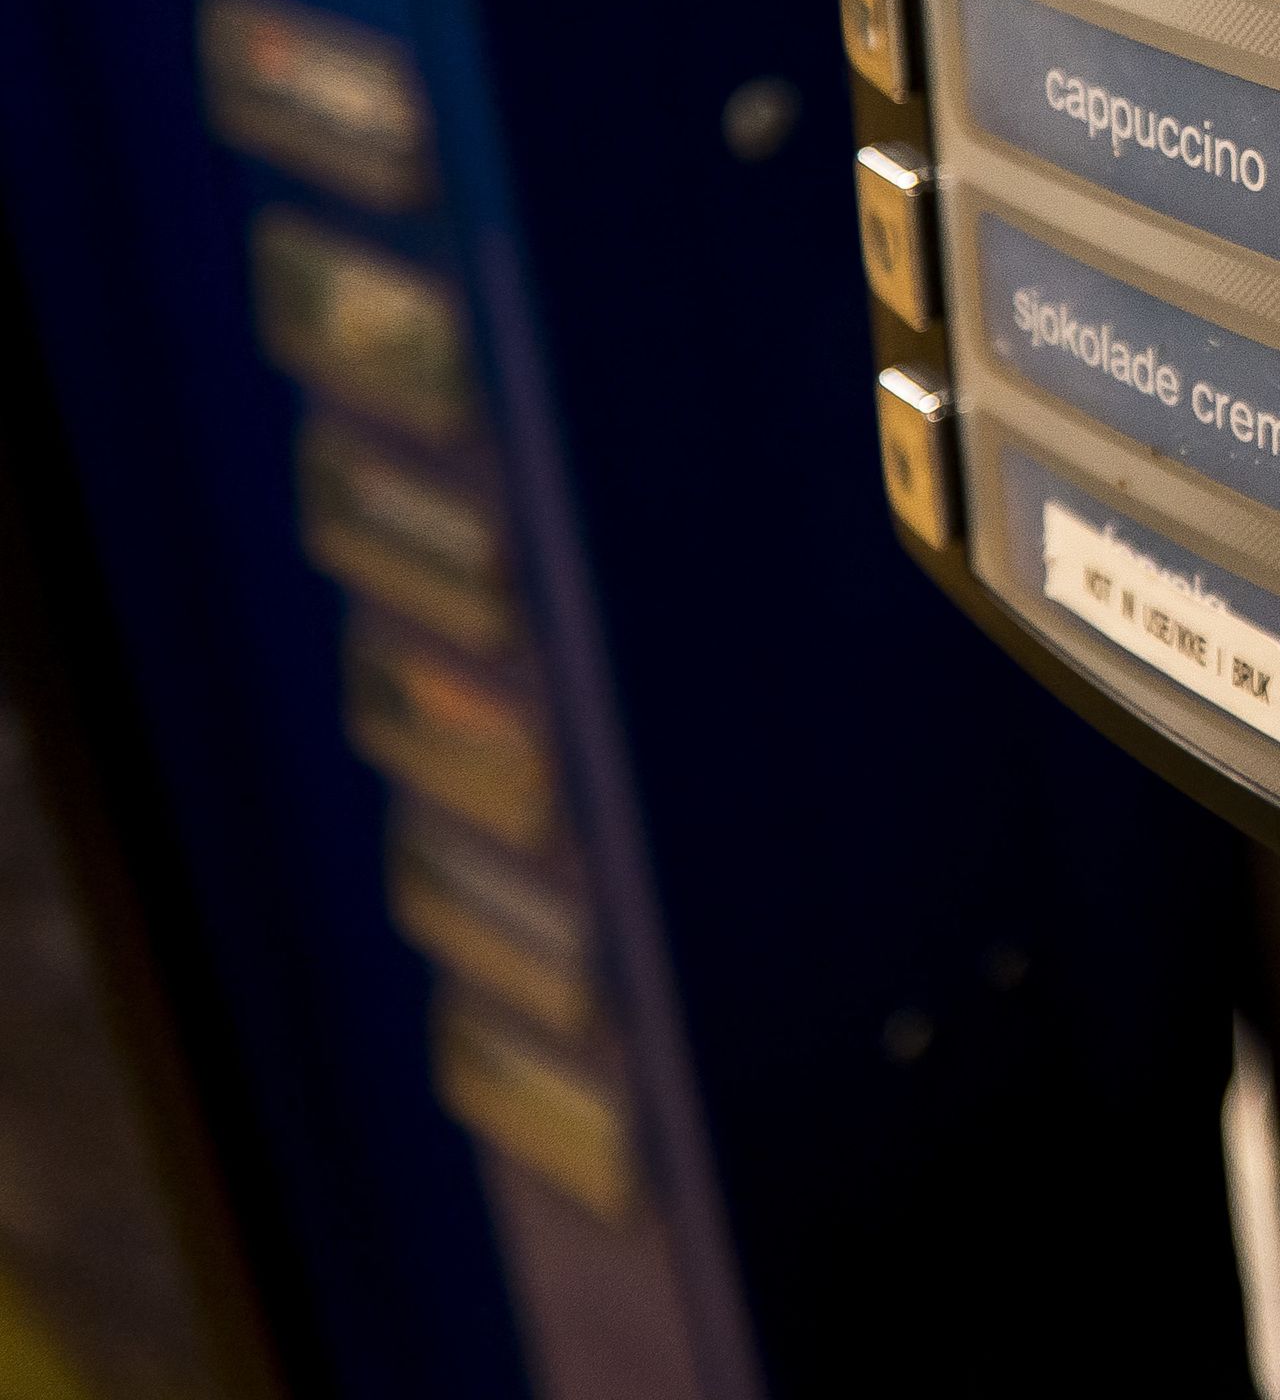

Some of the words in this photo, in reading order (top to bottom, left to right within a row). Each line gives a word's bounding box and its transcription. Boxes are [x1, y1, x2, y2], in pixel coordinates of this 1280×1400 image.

[1045, 68, 1266, 192] cappuccino
[1013, 287, 1181, 407] sjokolade
[1083, 566, 1112, 603] NOT
[1232, 656, 1271, 703] BRUK
